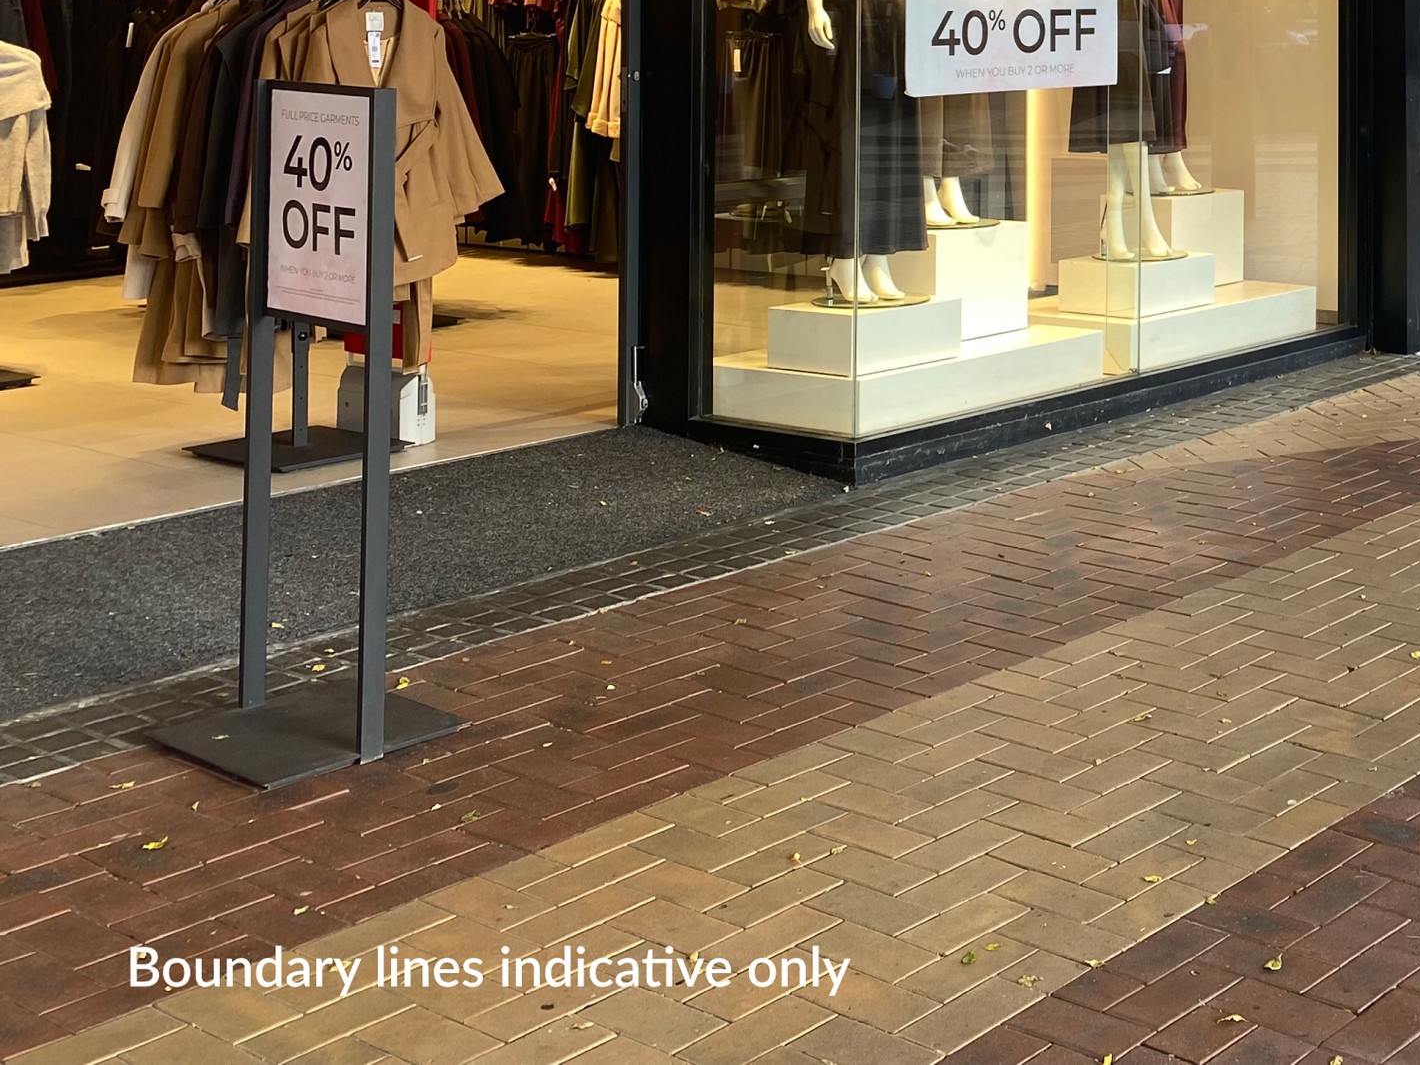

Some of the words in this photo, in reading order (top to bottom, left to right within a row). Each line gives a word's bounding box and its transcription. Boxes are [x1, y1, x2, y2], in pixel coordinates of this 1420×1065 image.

[931, 10, 1006, 56] 40%
[1013, 8, 1097, 54] OFF
[956, 67, 984, 79] WHEN
[986, 66, 1006, 78] YOU
[1008, 66, 1026, 76] BUY
[1026, 65, 1032, 75] 2
[1034, 64, 1048, 74] OR
[1050, 64, 1075, 74] MORE
[281, 109, 298, 121] FULL
[299, 113, 320, 123] PRICE
[320, 114, 360, 126] GARMENTS
[283, 135, 353, 191] 40%
[282, 199, 356, 256] OFF
